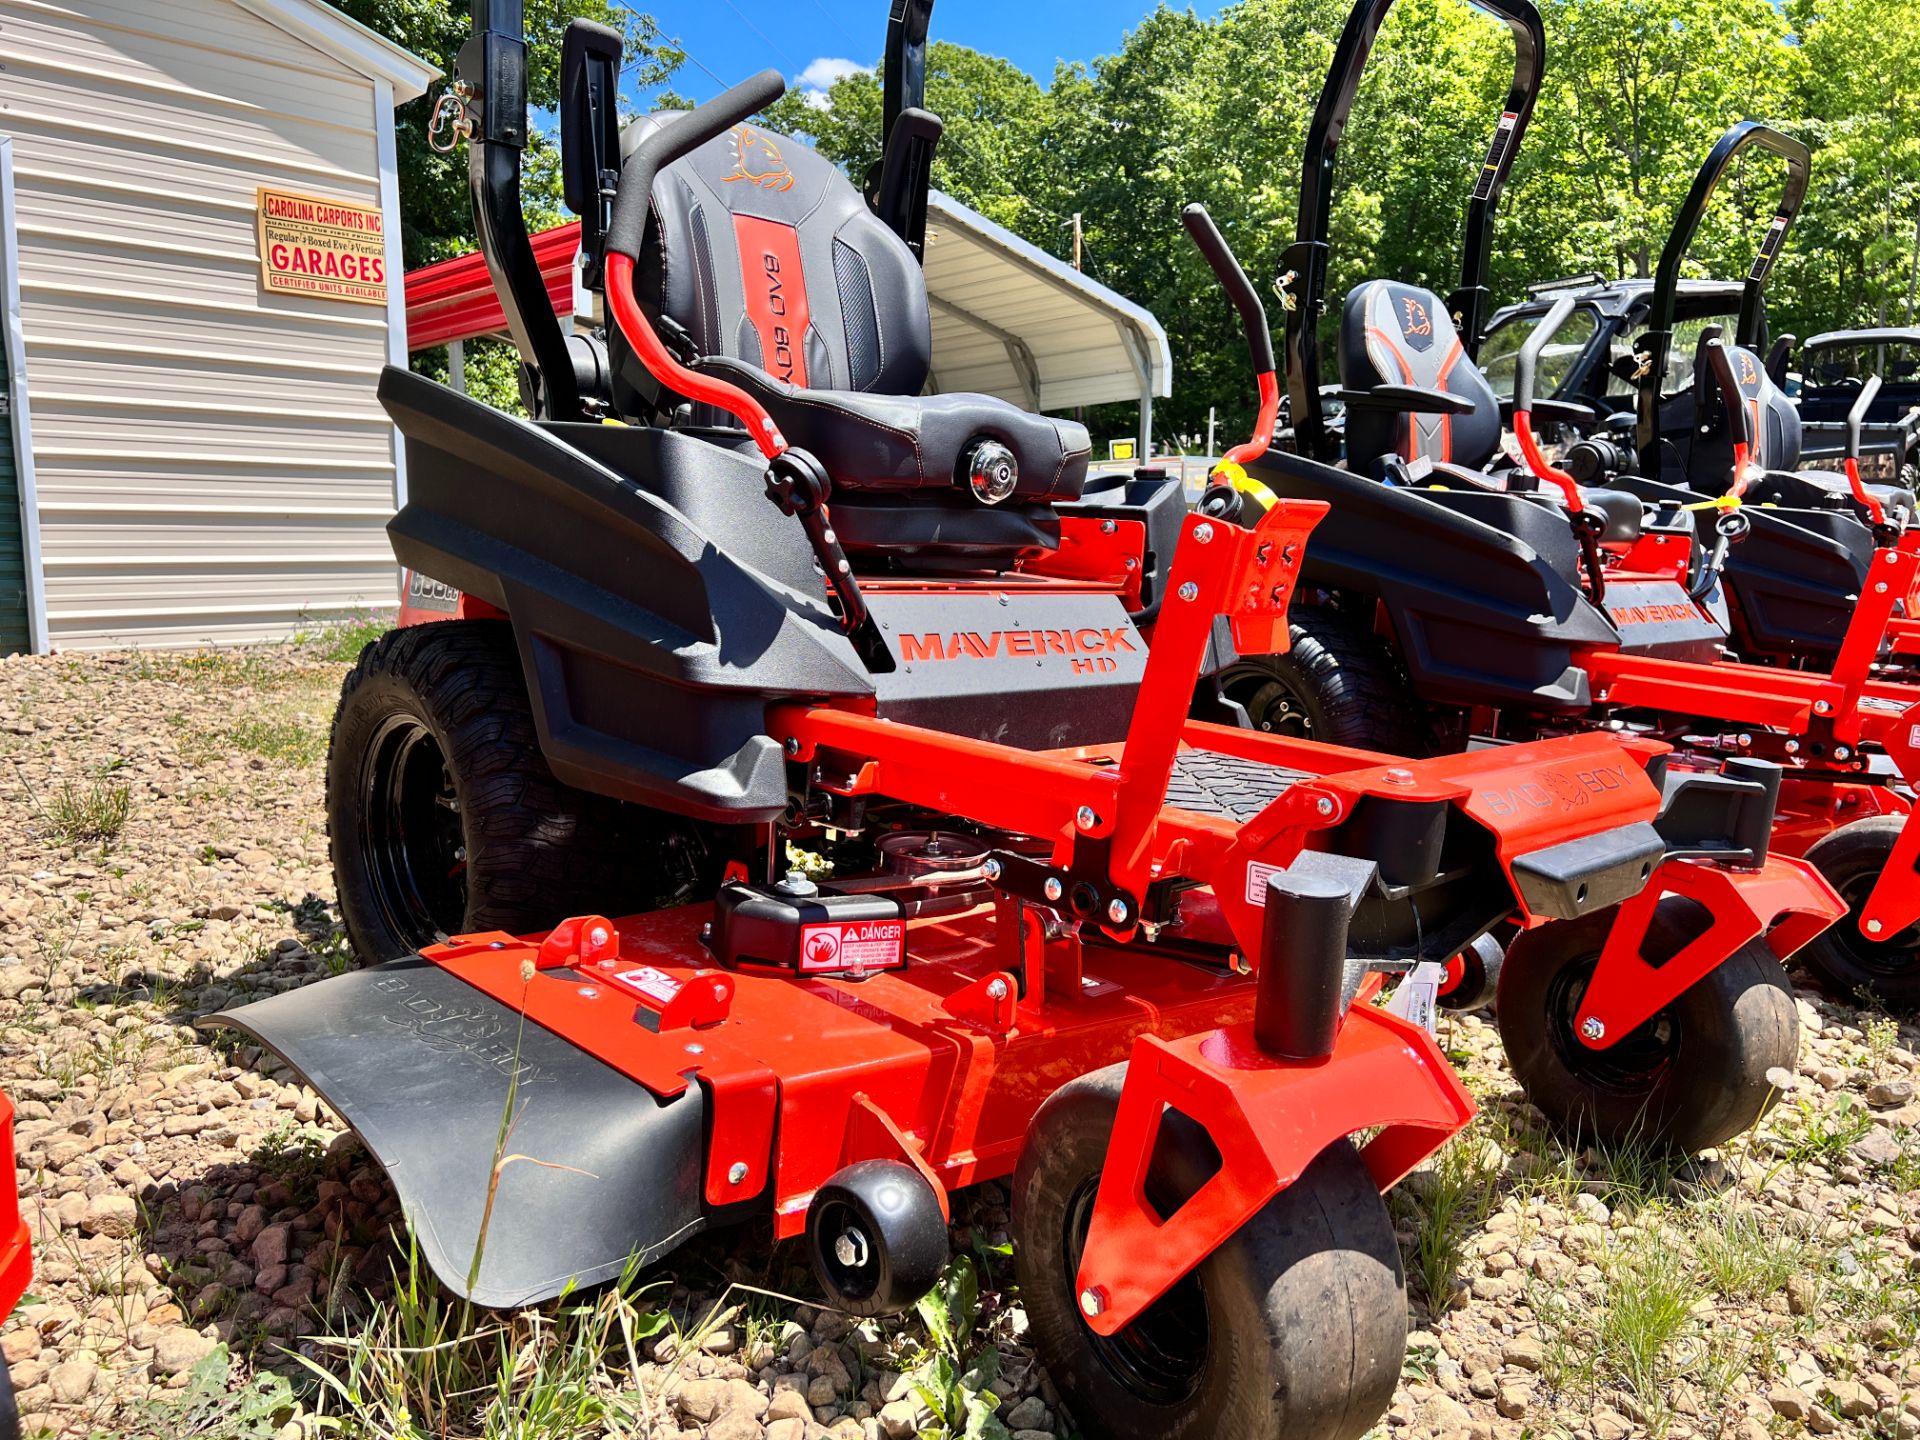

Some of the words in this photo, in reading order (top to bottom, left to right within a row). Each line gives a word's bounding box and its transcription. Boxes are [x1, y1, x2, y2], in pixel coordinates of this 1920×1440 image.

[268, 197, 315, 222] CAROLINA
[317, 206, 363, 230] CARPORTS
[366, 214, 381, 233] INC
[265, 220, 298, 229] QUALITY
[351, 233, 385, 243] PRIORITY
[268, 229, 300, 244] Regular
[308, 235, 332, 249] Boxed
[333, 240, 348, 252] Eve
[355, 243, 384, 256] Vertical
[271, 244, 385, 284] GARAGES
[272, 276, 316, 290] CERTIFIED
[319, 283, 343, 294] UNITS
[345, 286, 387, 300] AVAILABLE
[764, 253, 786, 316] BAD
[1611, 603, 1699, 626] MAVERICK
[898, 628, 1137, 662] MAVERICK
[1070, 657, 1118, 675] HD
[1480, 783, 1552, 816] BAD
[1576, 764, 1632, 793] BOY
[860, 925, 901, 940] DANGER
